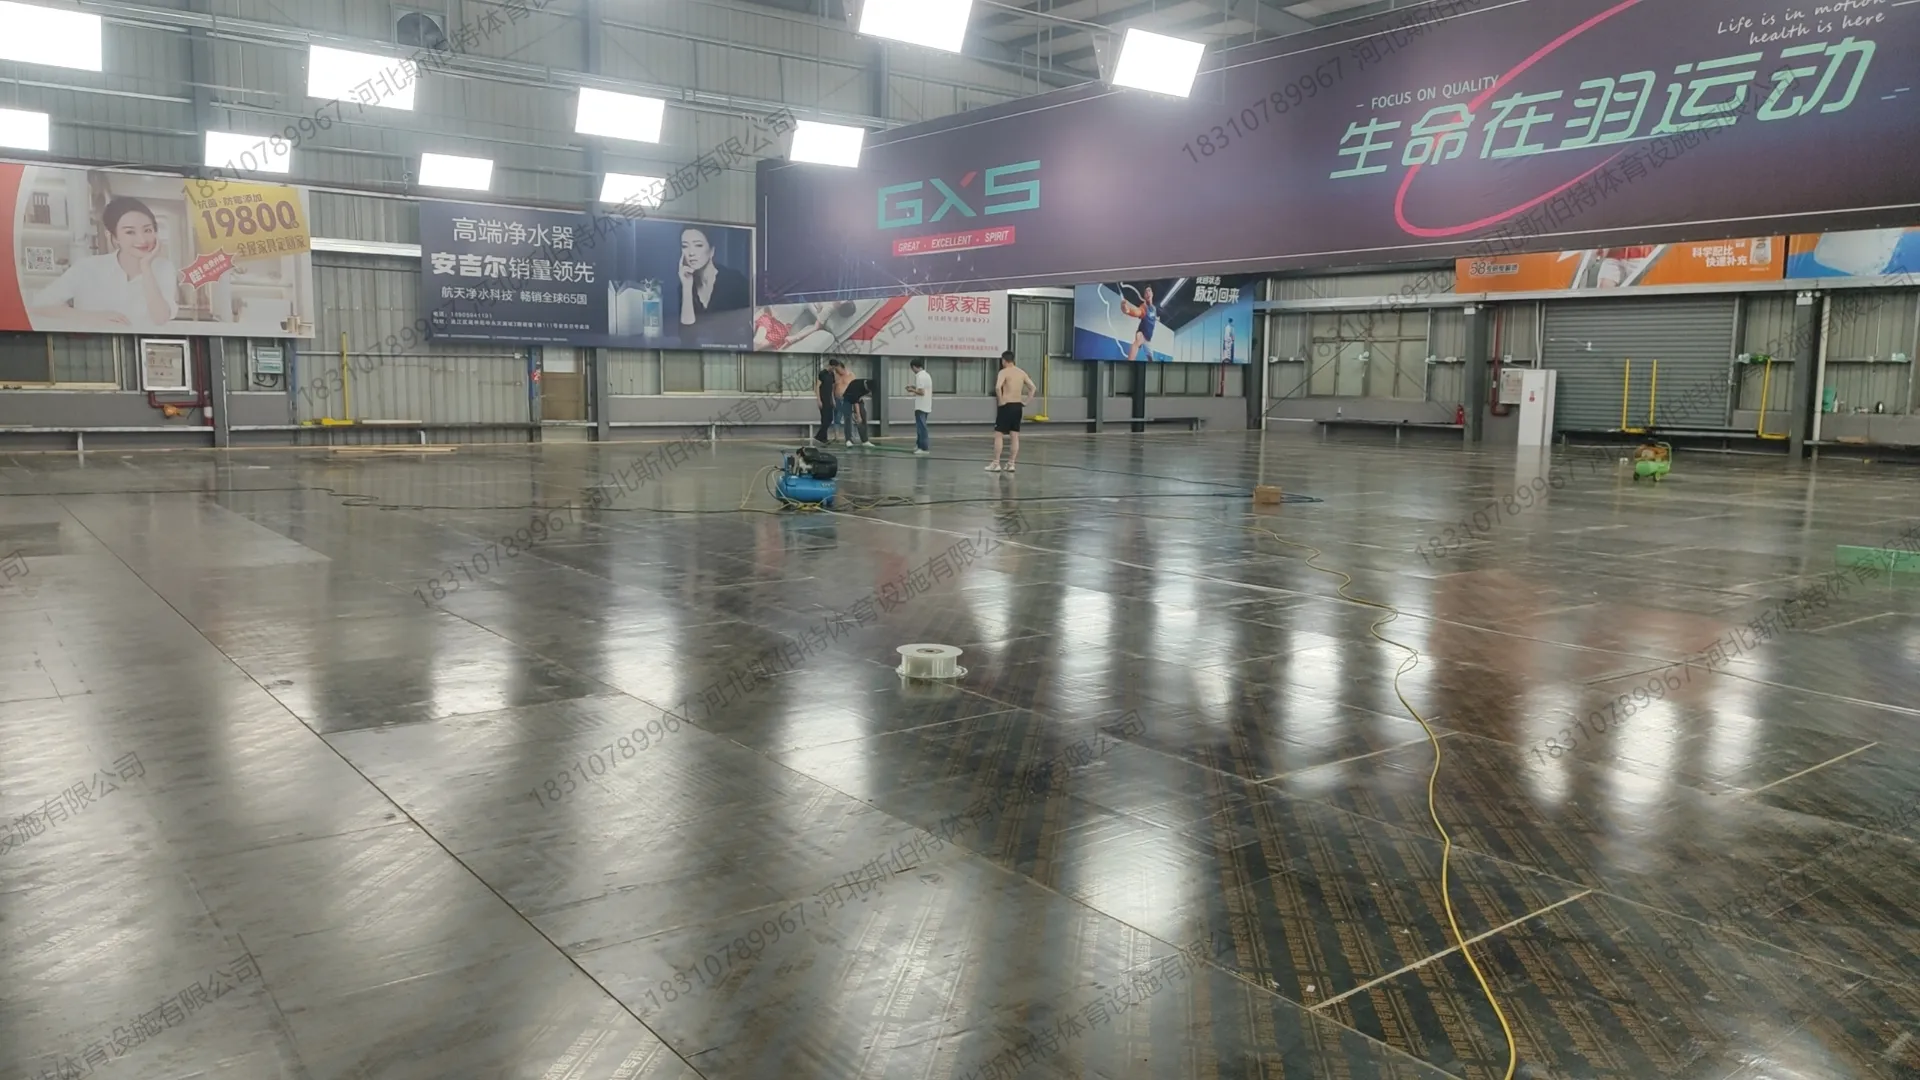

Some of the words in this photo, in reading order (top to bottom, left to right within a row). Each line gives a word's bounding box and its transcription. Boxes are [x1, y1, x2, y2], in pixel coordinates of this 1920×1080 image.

[1718, 17, 1753, 35] Life
[1762, 12, 1776, 26] is
[1785, 8, 1805, 21] in
[1750, 24, 1810, 45] health
[1818, 20, 1833, 33] is
[1842, 12, 1886, 30] here
[1330, 36, 1877, 179] 生命在羽运动
[1371, 91, 1412, 110] FOCUS
[1417, 87, 1436, 102] ON
[1442, 75, 1500, 97] QUALITY
[878, 160, 1041, 229] GXS
[452, 217, 575, 250] 高端净水器
[898, 241, 920, 252] GREAT
[931, 235, 973, 249] EXCELLENT
[984, 230, 1010, 243] SPIRIT
[431, 252, 595, 283] 安吉尔销量领先
[520, 291, 588, 305] 畅销全球65国
[928, 294, 991, 315] 顾家家居
[1193, 285, 1240, 306] 脉动回来
